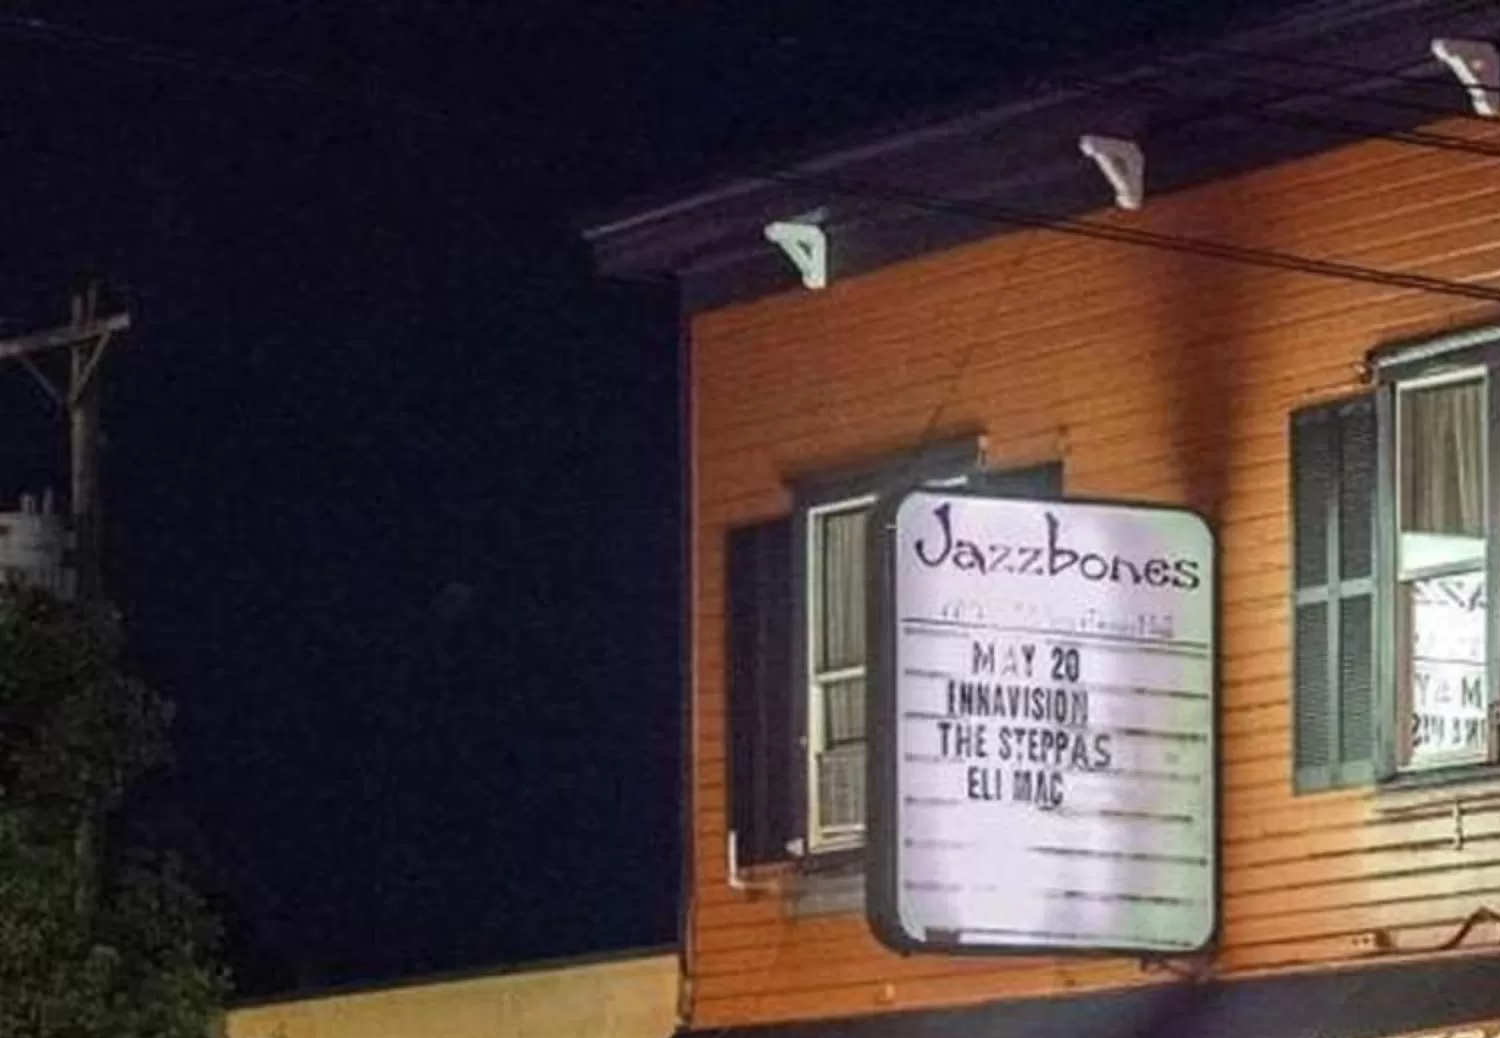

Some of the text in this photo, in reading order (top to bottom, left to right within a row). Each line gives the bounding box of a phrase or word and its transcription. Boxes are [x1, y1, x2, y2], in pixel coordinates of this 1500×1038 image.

[914, 502, 1201, 589] Jazzbones
[971, 640, 1080, 683] MAY 20
[947, 679, 1089, 726] INNAVISION
[937, 721, 1112, 768] THE STEPPAS
[967, 766, 1064, 807] ELI MAC
